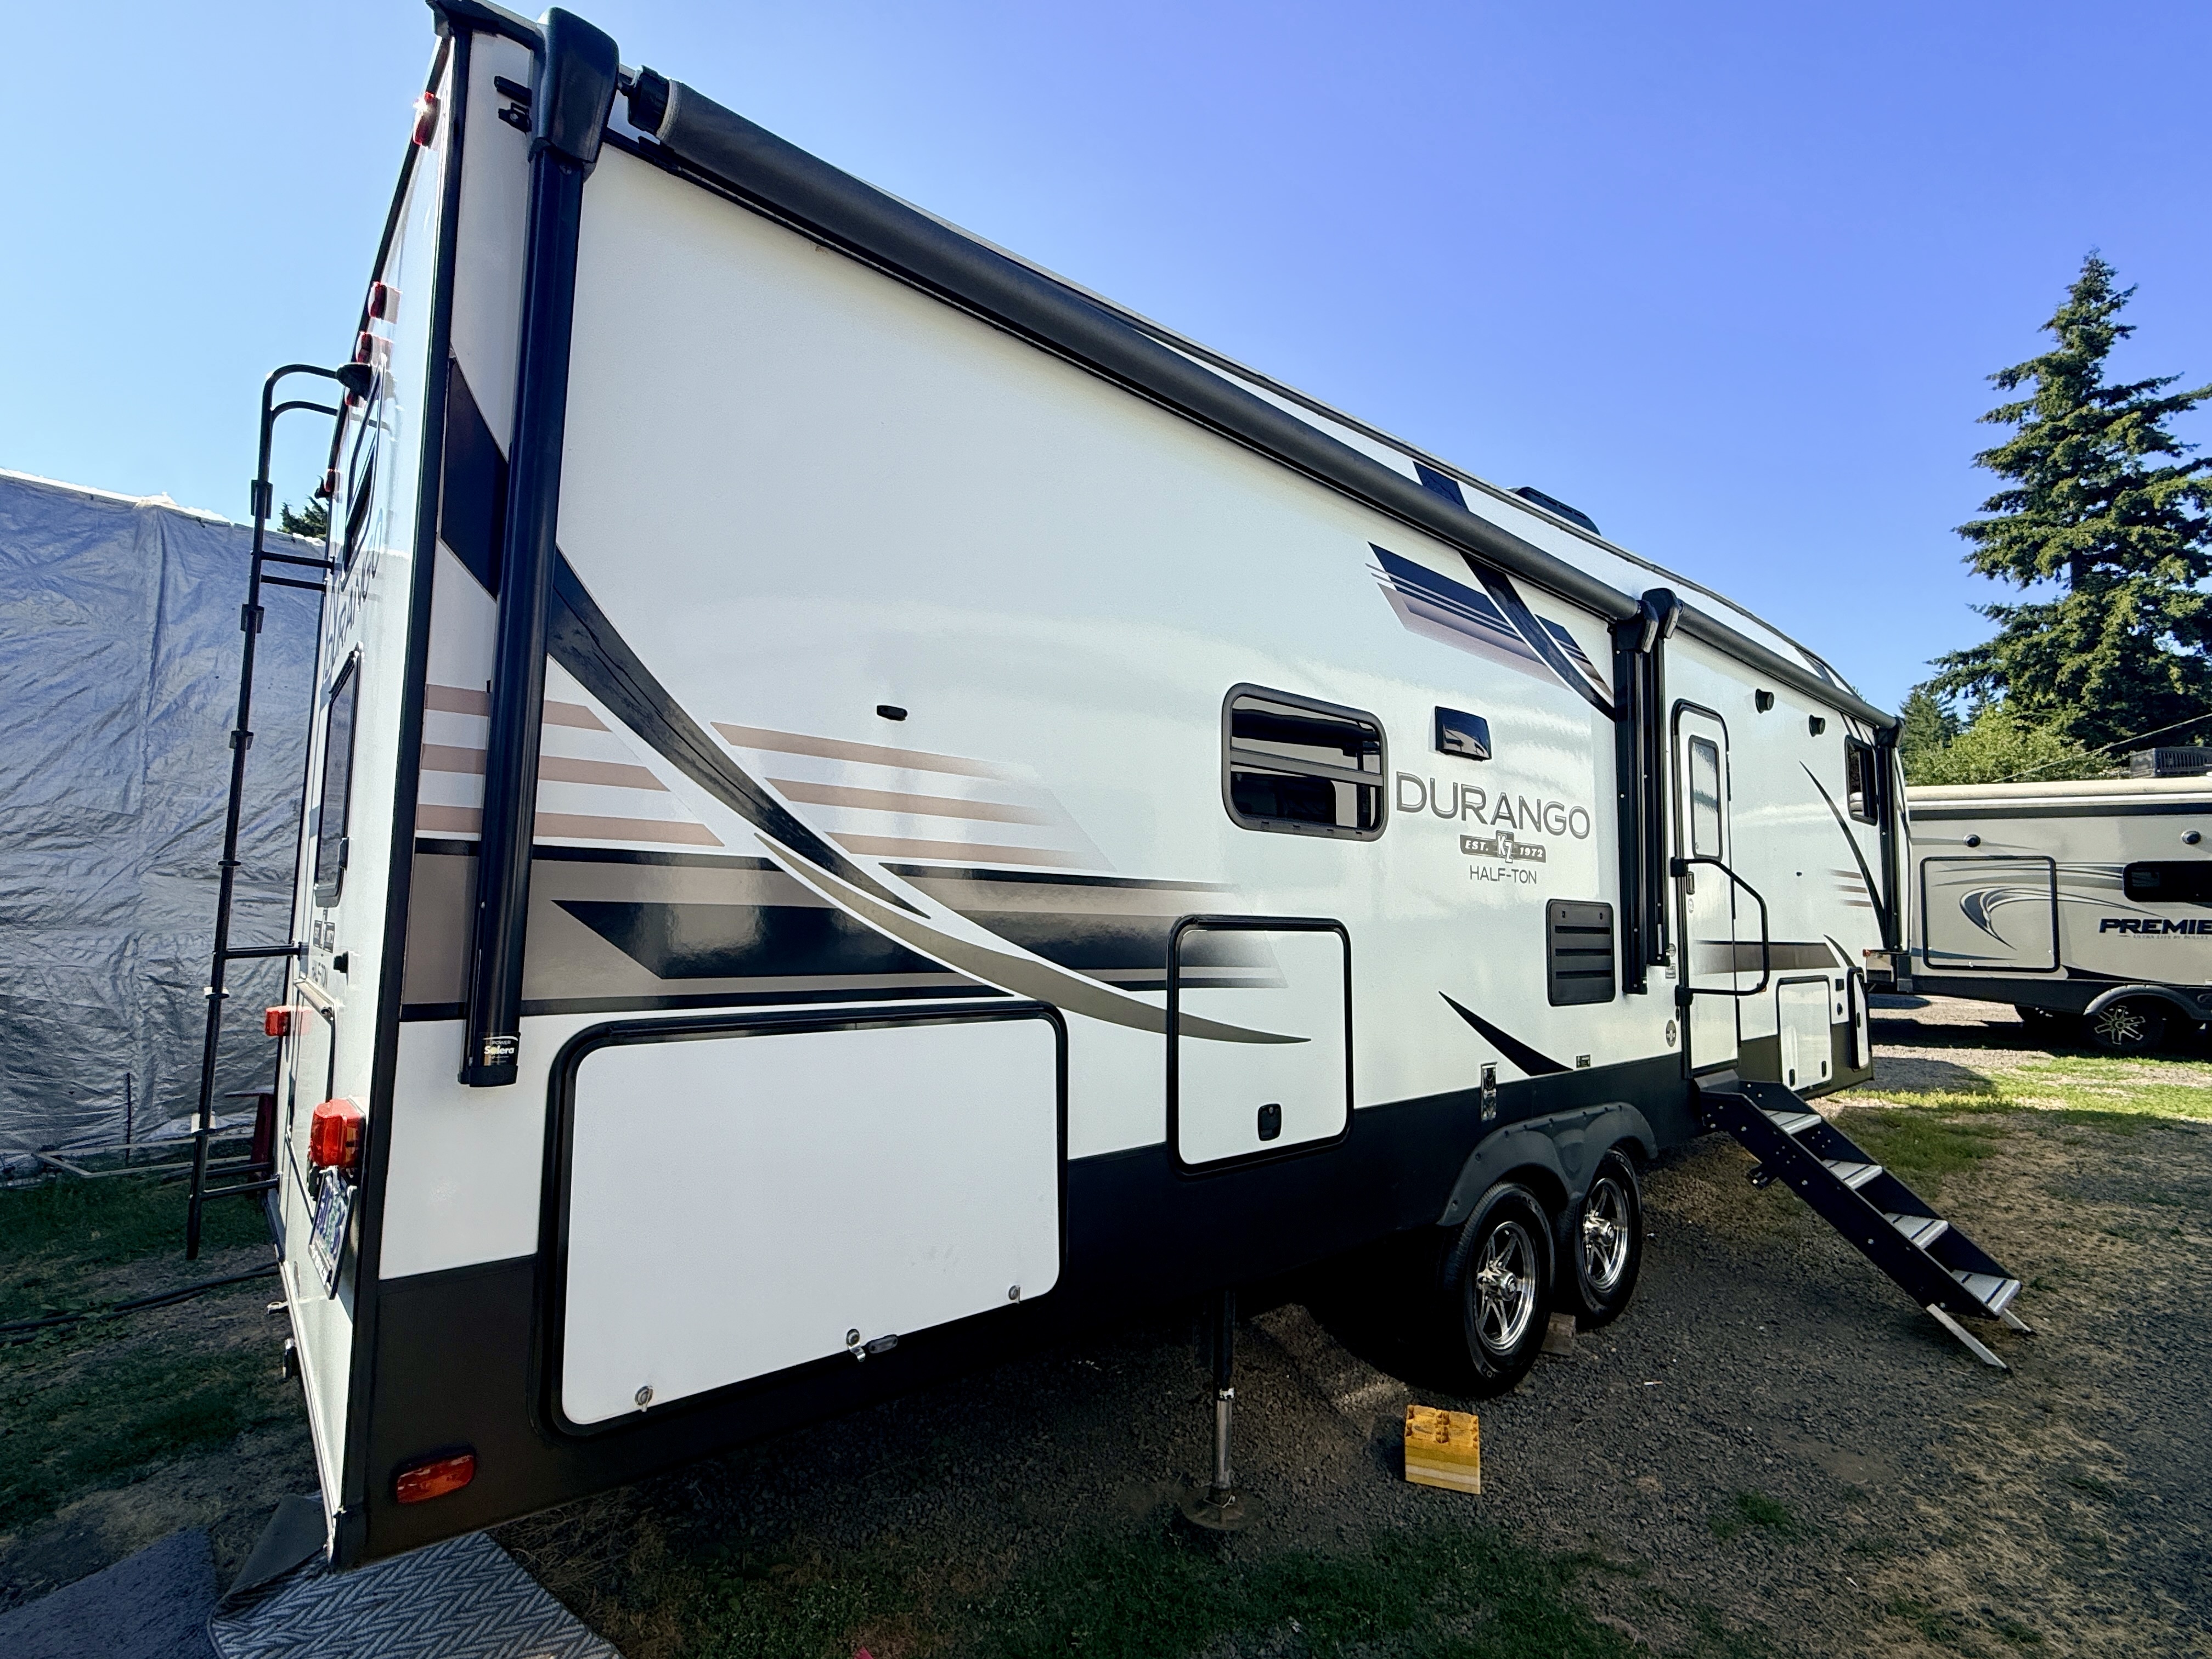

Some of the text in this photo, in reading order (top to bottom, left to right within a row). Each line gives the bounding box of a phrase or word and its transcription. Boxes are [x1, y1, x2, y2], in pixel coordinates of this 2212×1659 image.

[1397, 771, 1590, 839] DURANGO
[1465, 833, 1543, 863] EST. KZ 1972
[1470, 865, 1537, 884] HALF-TON
[484, 1045, 515, 1054] Solera
